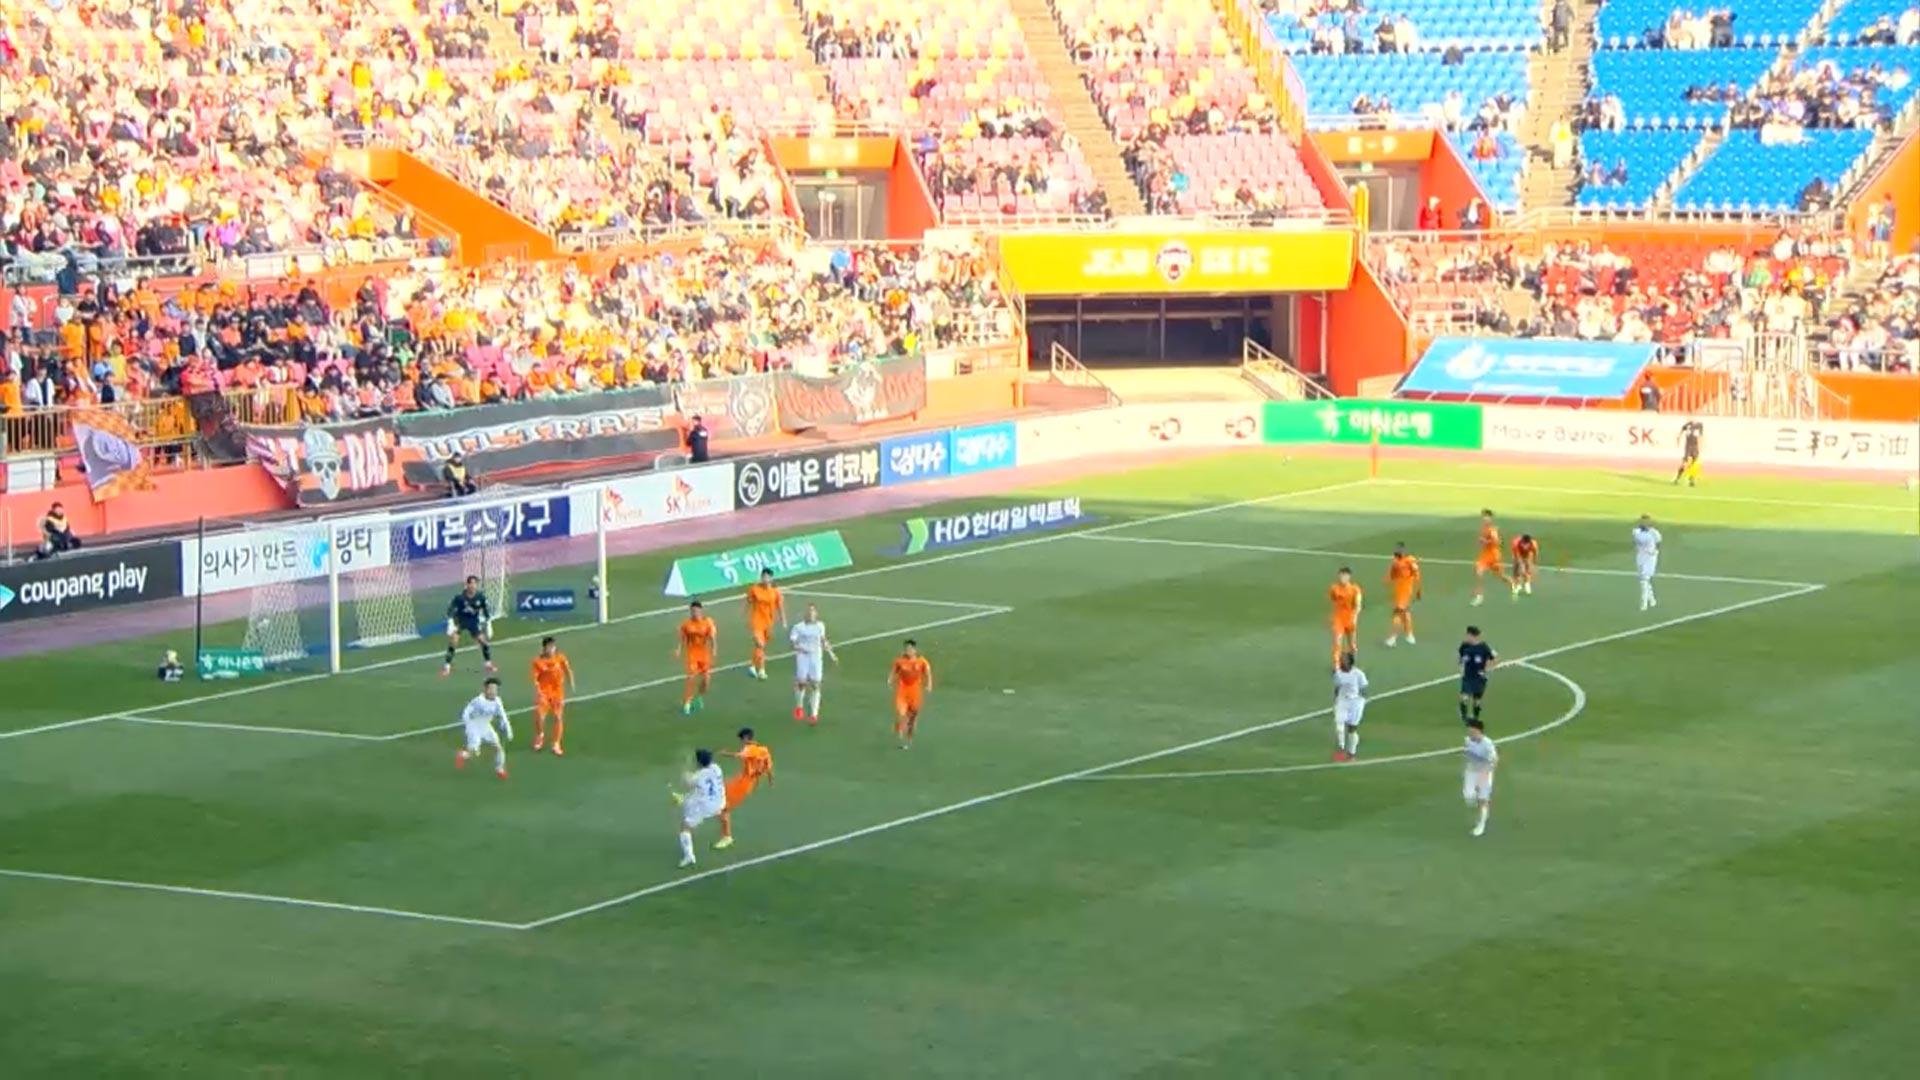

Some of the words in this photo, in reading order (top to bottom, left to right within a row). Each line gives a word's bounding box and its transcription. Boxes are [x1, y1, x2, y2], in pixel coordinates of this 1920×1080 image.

[1774, 427, 1909, 460] 三和石油
[767, 458, 821, 498] 이불은
[825, 449, 880, 487] 데코뷰
[203, 545, 258, 578] 의사가
[262, 540, 298, 571] 만든
[744, 540, 820, 572] 하나은행
[20, 571, 105, 606] coupang
[107, 561, 149, 598] play
